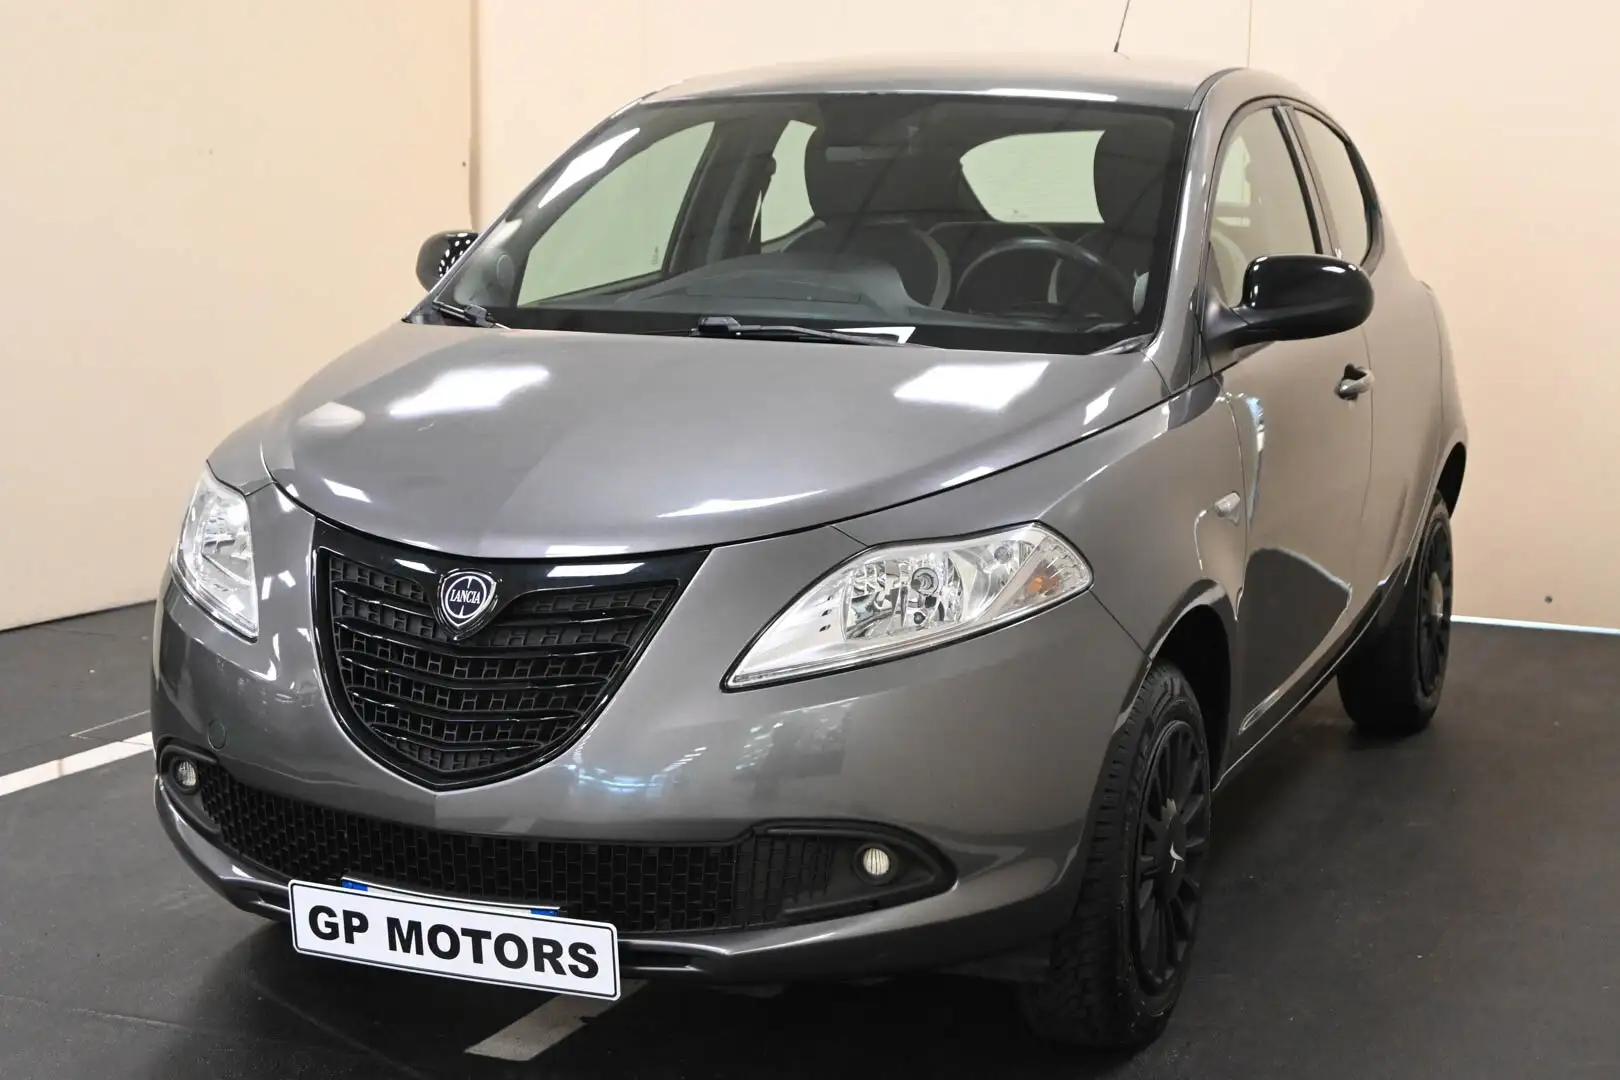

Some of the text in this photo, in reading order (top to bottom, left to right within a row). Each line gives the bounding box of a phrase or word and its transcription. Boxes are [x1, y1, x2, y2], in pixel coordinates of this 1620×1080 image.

[449, 589, 481, 604] LANCIA
[308, 905, 599, 979] GP MOTORS
